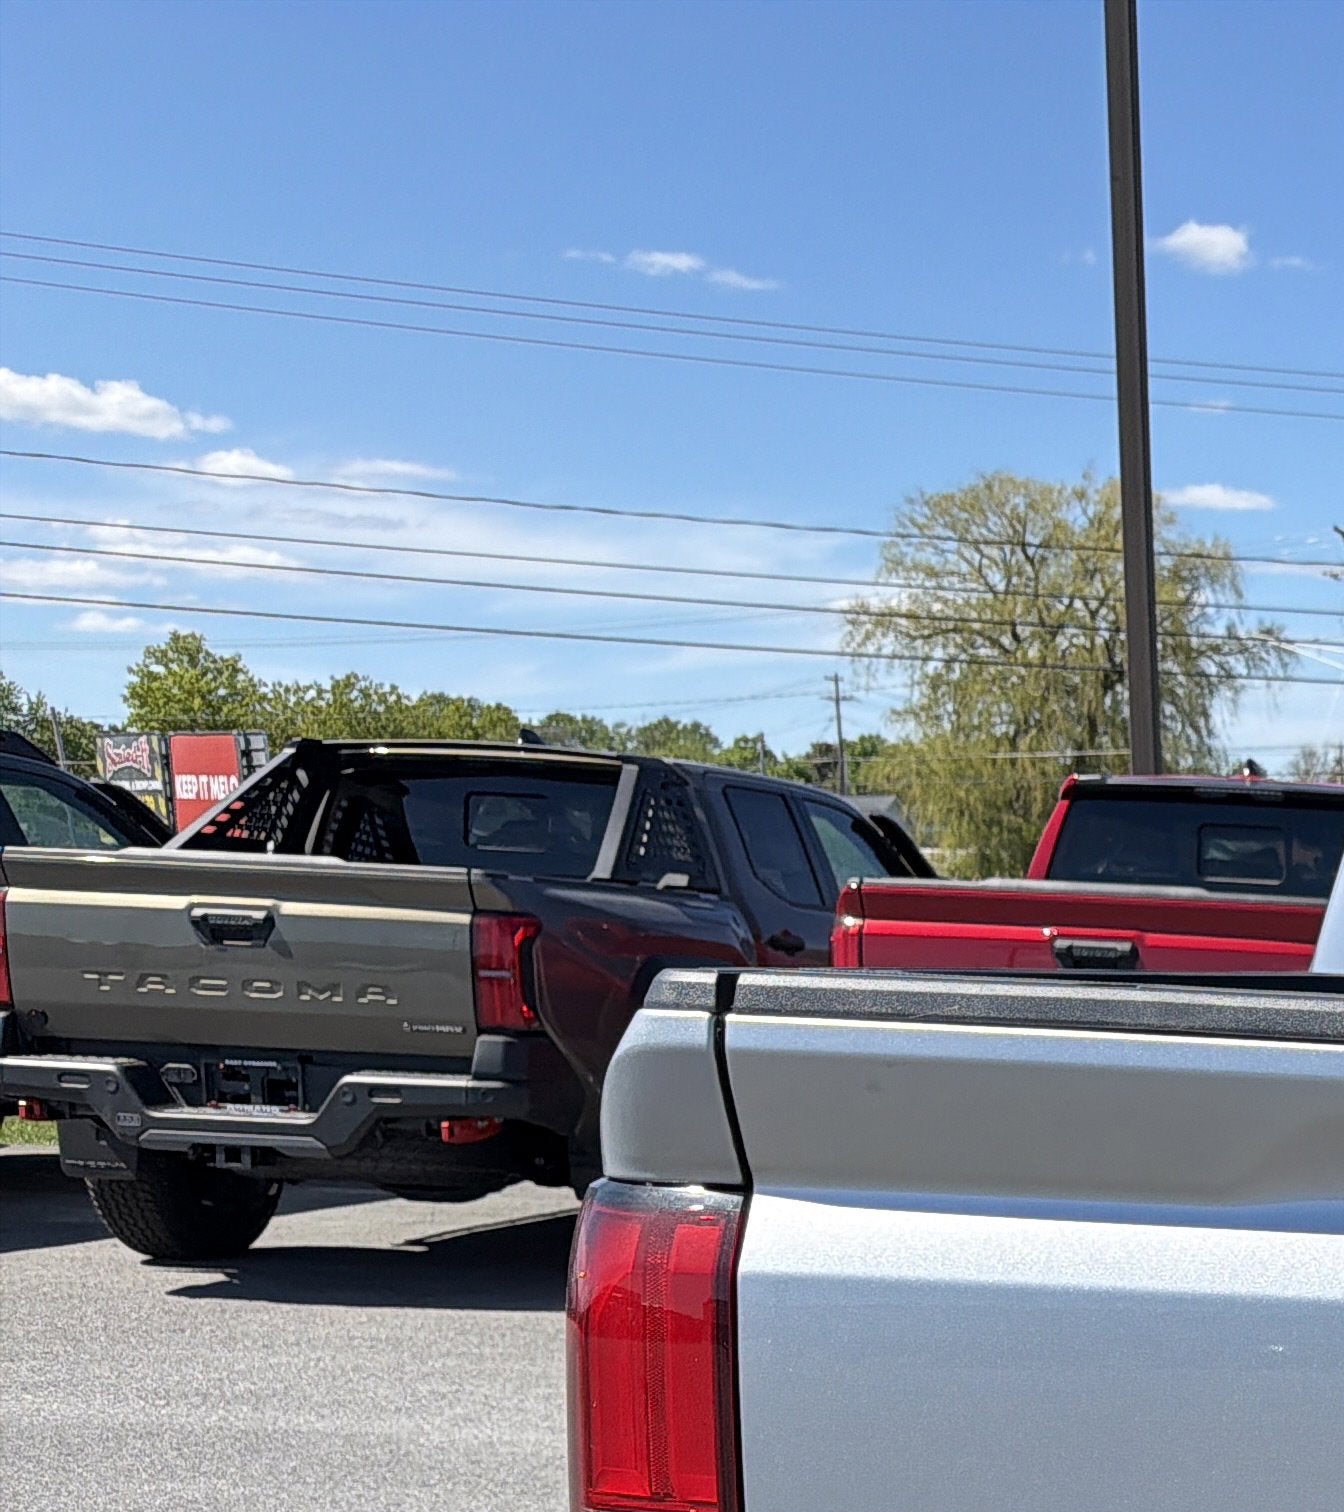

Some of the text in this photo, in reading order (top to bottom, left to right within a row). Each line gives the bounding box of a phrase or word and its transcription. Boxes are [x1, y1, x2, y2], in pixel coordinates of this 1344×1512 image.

[175, 774, 198, 800] KEEP
[199, 775, 209, 801] IT
[81, 971, 399, 1005] TACOMA
